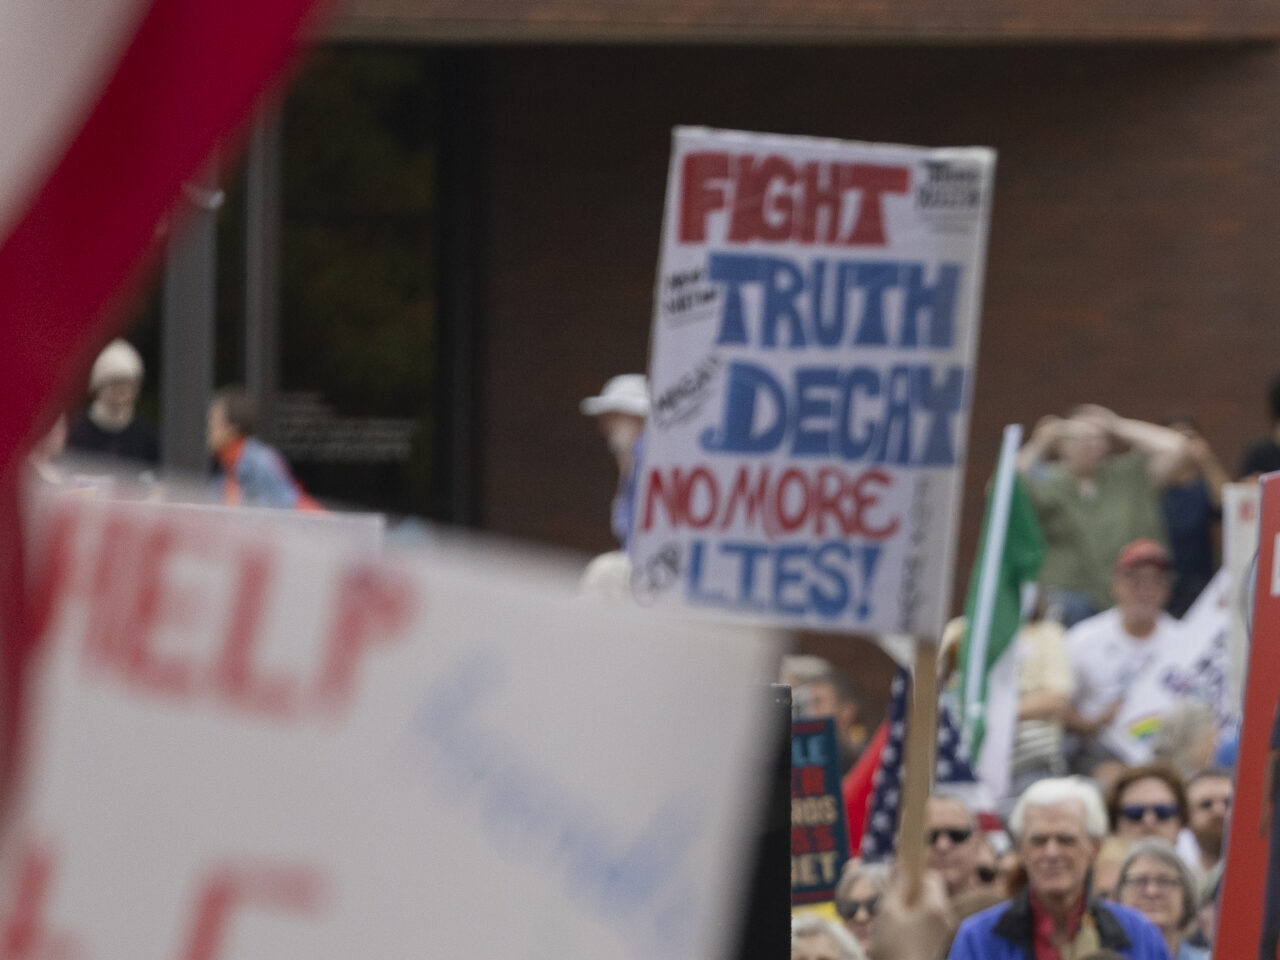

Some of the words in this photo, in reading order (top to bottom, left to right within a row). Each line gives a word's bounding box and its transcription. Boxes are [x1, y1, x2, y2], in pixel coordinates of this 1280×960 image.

[679, 153, 911, 246] FIGHT
[707, 252, 964, 349] TRUTH
[699, 360, 967, 466] DECAY
[642, 467, 718, 531] NO
[719, 467, 901, 540] MORE
